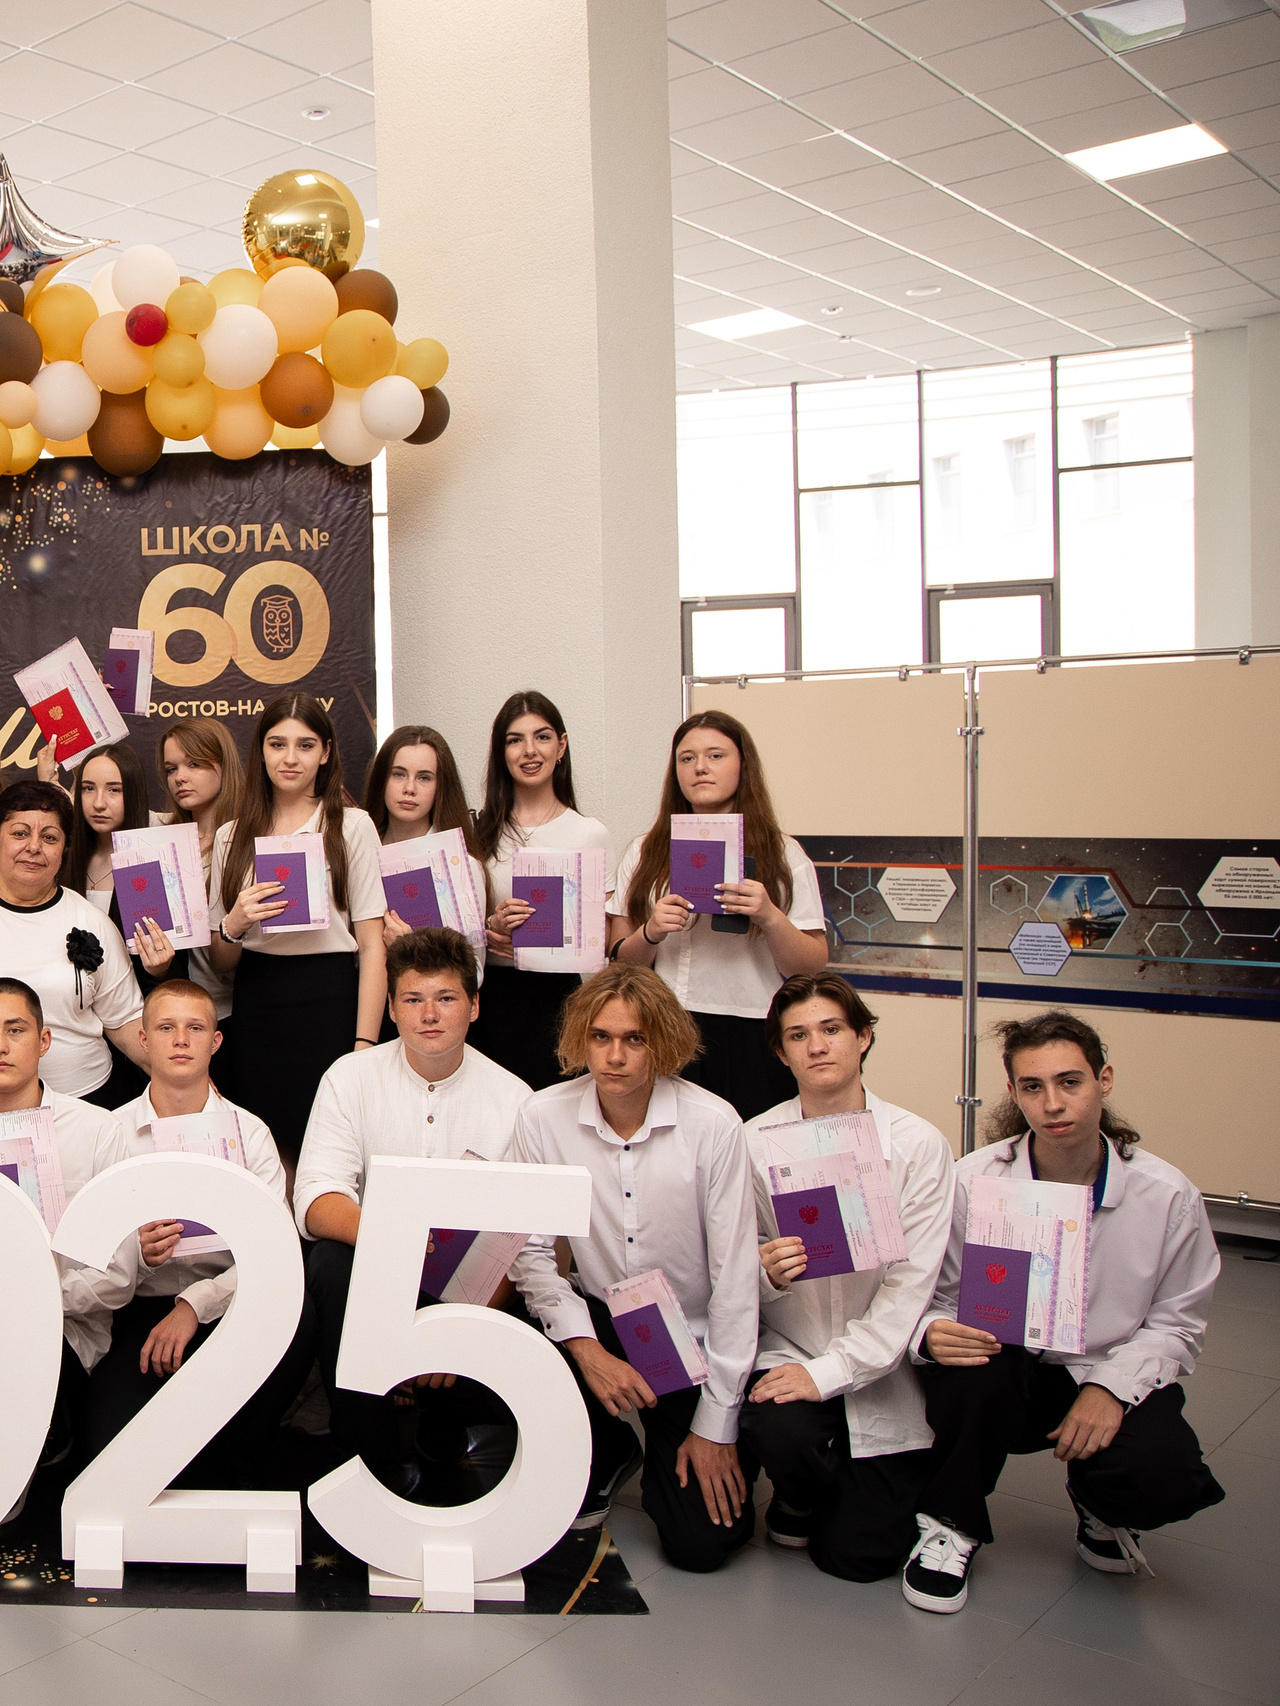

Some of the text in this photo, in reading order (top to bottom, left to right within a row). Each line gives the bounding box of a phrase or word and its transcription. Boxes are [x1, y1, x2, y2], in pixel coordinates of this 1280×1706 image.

[140, 522, 329, 556] ШКОЛА №
[137, 560, 331, 687] 60
[806, 1243, 834, 1253] ТТЕСТАТ
